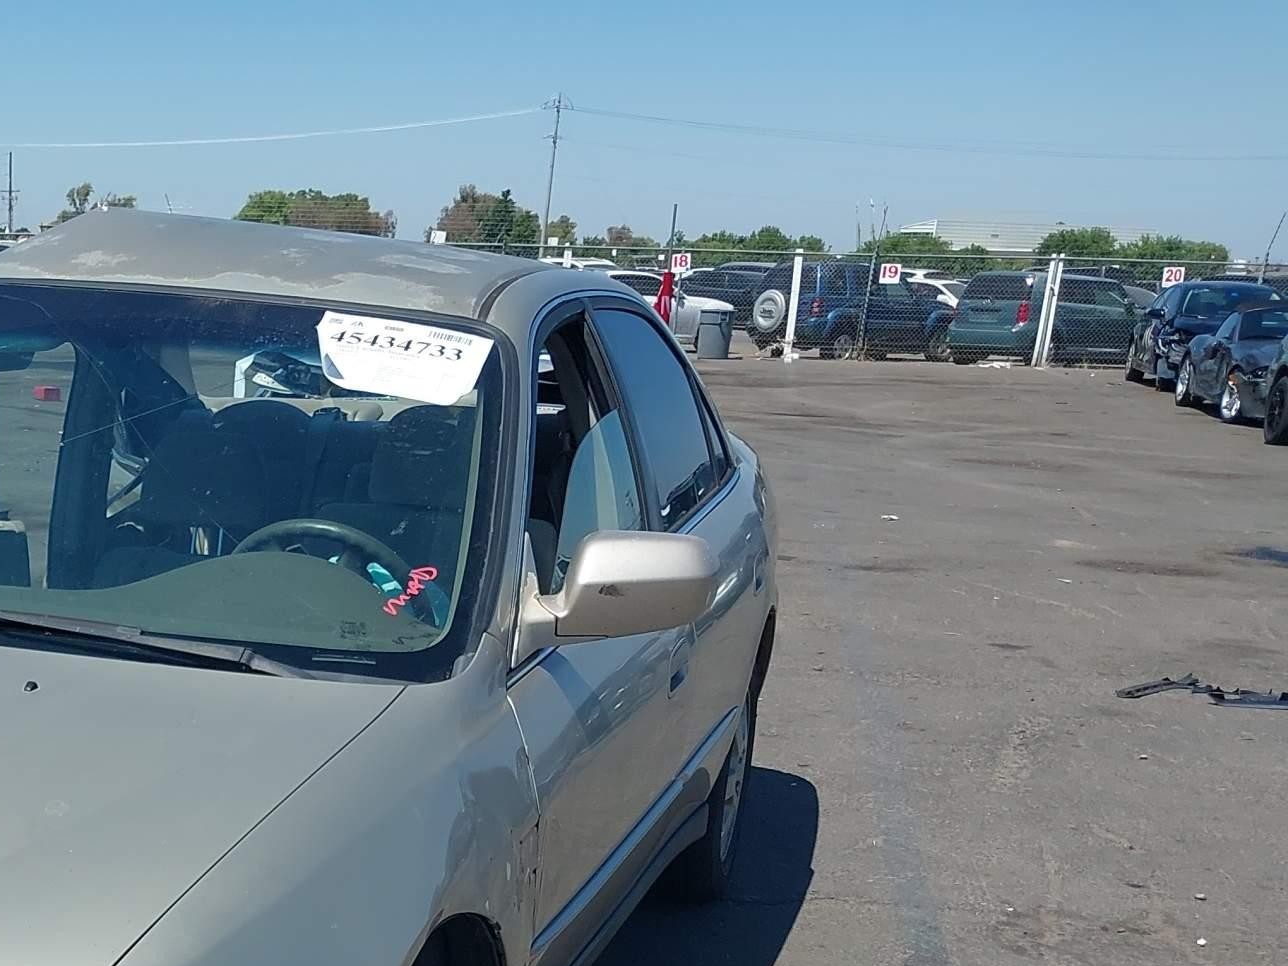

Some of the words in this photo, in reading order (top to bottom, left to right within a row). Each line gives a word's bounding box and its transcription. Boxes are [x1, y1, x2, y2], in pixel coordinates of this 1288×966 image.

[674, 255, 688, 268] 18
[882, 265, 898, 279] 19
[1164, 268, 1183, 283] 20
[330, 330, 463, 361] 45434733
